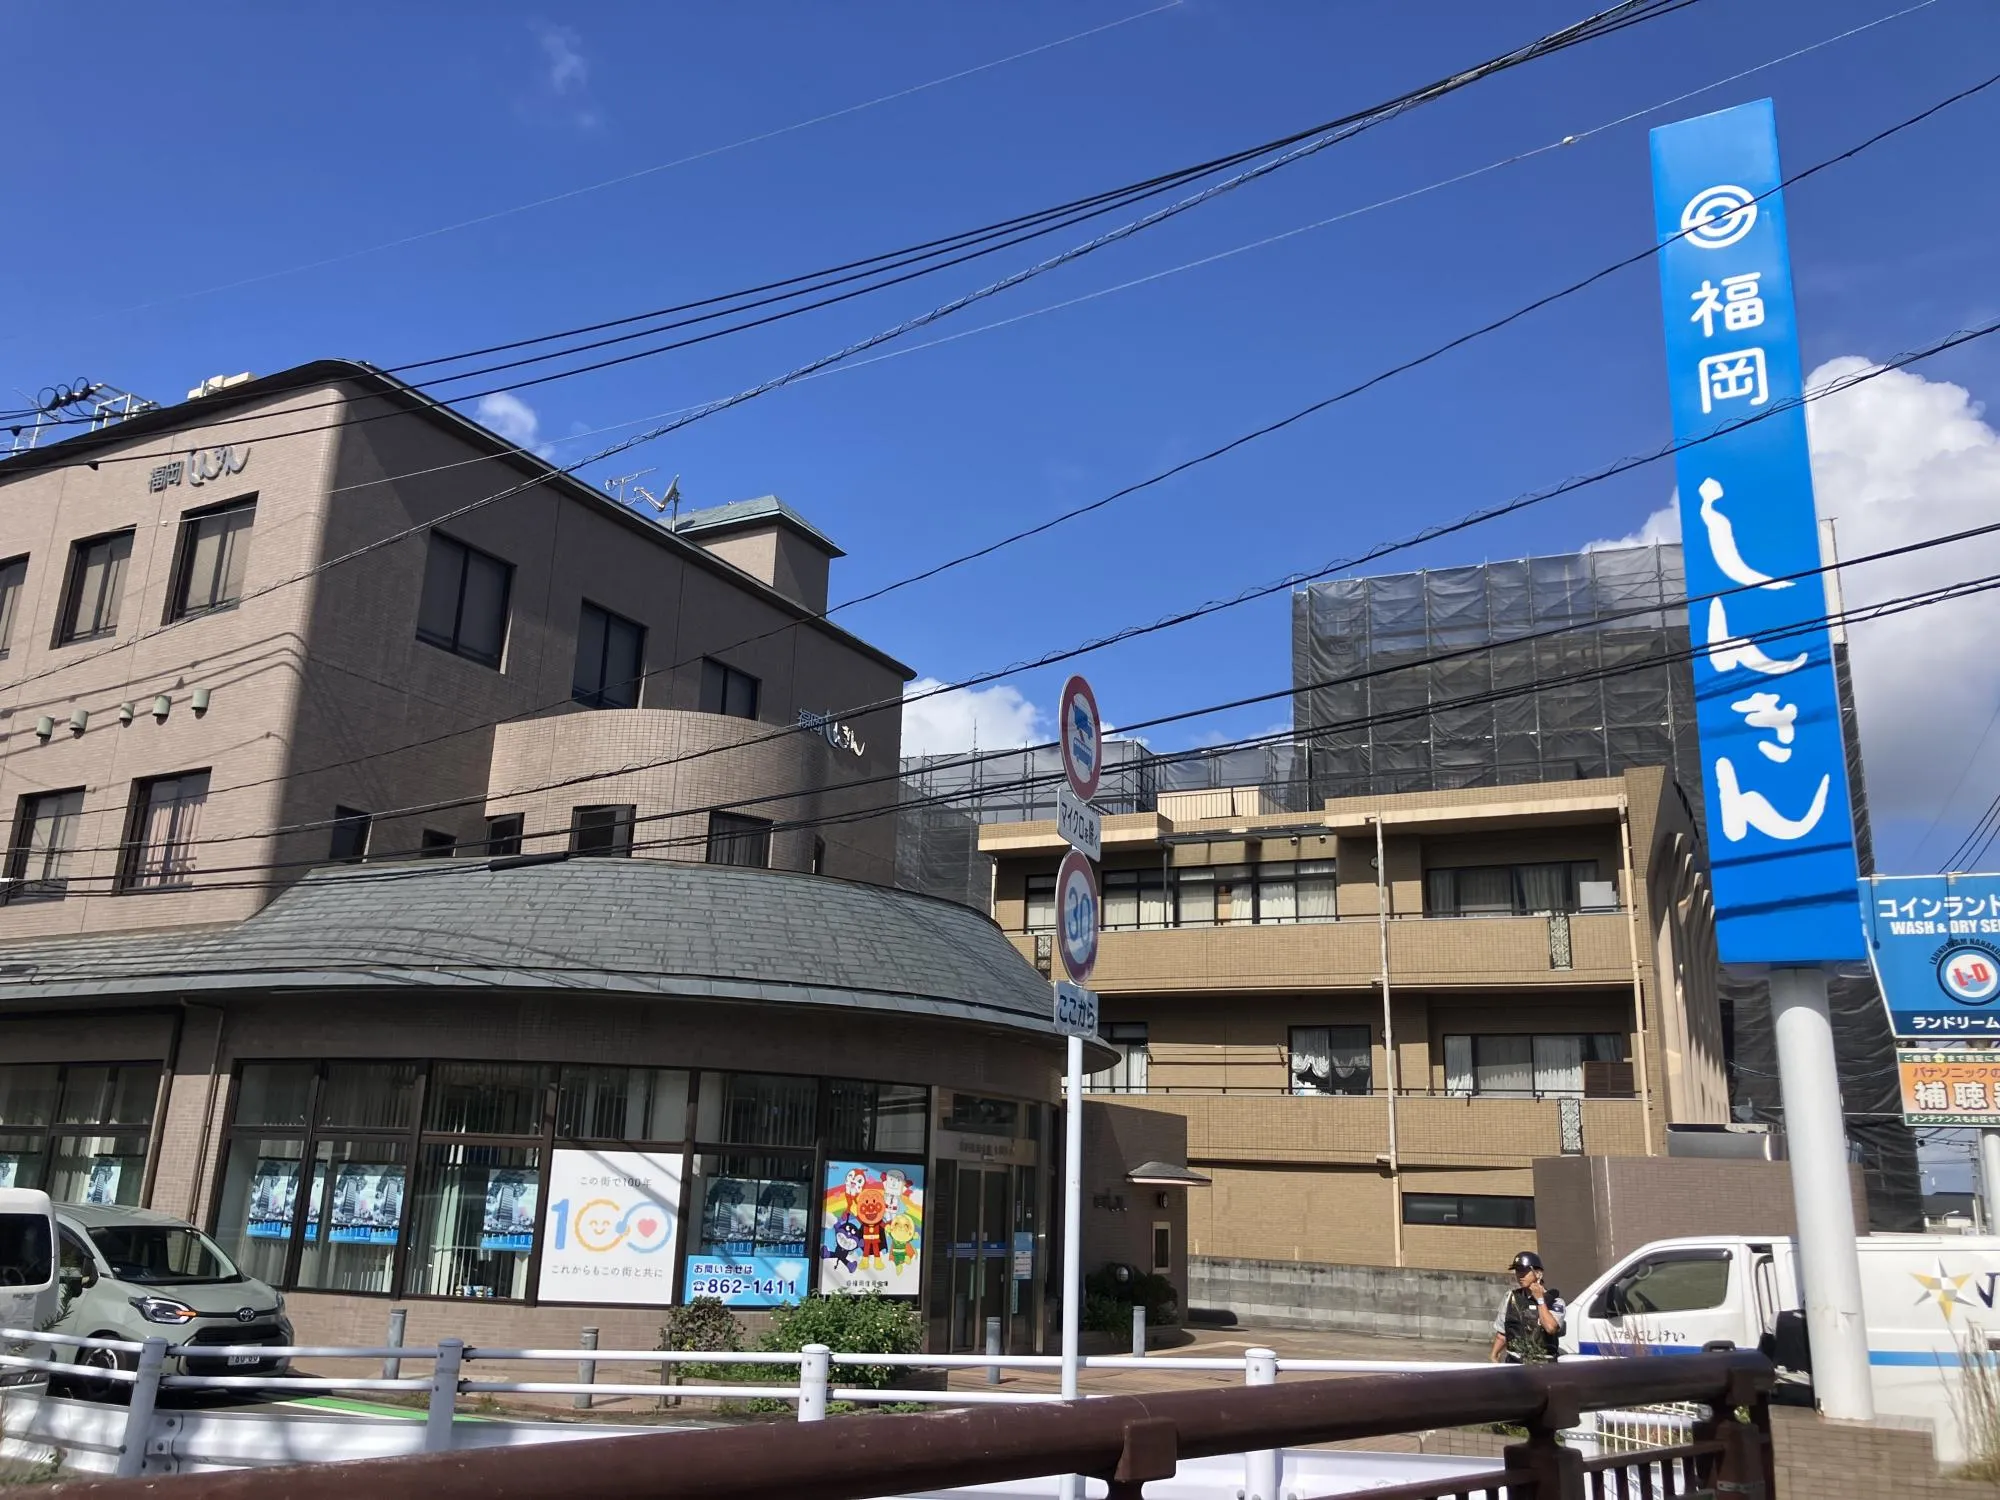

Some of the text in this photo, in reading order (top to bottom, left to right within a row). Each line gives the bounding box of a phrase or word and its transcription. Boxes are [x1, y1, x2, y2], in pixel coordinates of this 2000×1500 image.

[1690, 271, 1830, 842] 福岡 しんきん
[1068, 886, 1091, 947] 30
[1890, 919, 2000, 935] WASH & DRY SE
[1954, 963, 1989, 987] L-D
[1059, 994, 1095, 1030] ここから
[1914, 1081, 2000, 1110] 補聴
[580, 1176, 652, 1188] この街で100年
[551, 1265, 663, 1278] これからもこの街と共に
[694, 1264, 753, 1275] お問い合せは
[708, 1279, 795, 1294] 862-1411
